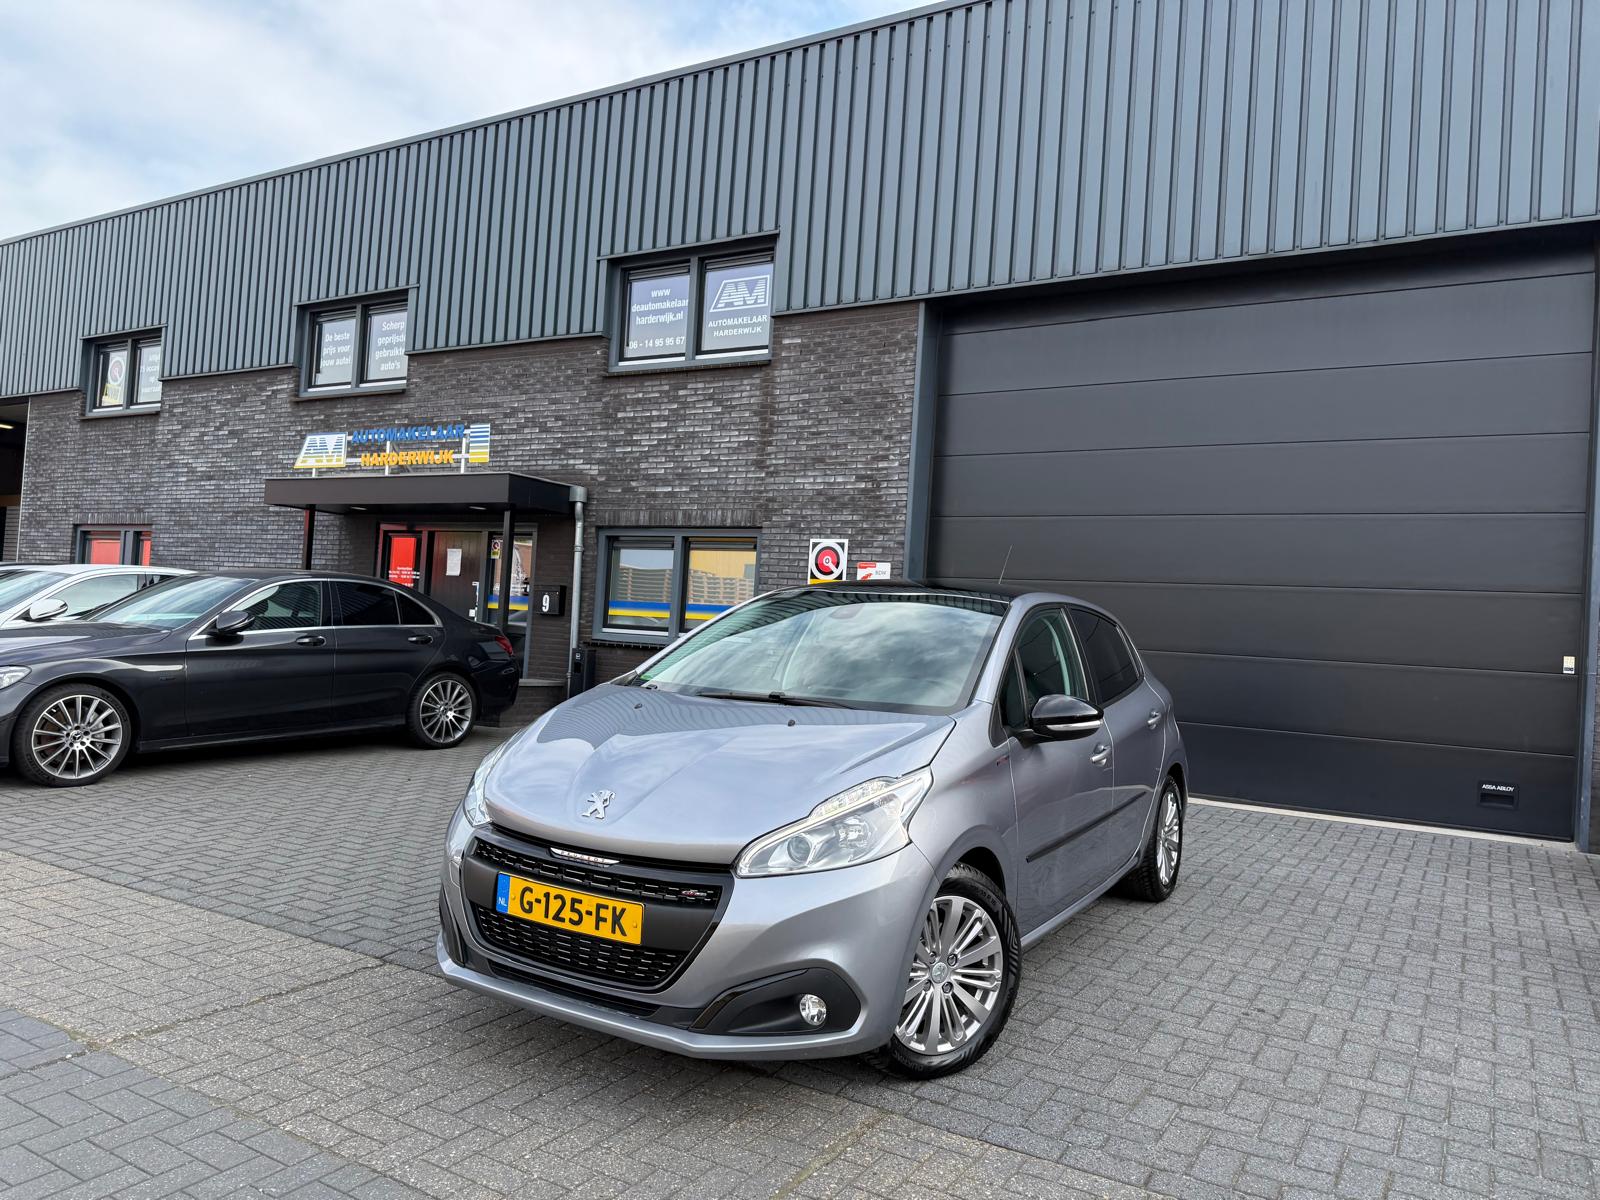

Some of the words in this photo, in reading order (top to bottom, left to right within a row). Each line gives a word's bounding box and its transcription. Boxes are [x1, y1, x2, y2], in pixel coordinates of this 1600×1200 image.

[651, 288, 671, 298] www
[636, 310, 683, 325] harderwijk.nl
[708, 314, 768, 328] AUTOMAKELAAR
[382, 320, 404, 331] Scherp
[713, 326, 762, 337] HARDERWIJK
[334, 331, 350, 341] beste
[630, 340, 638, 349] 06
[645, 339, 652, 348] 14
[655, 338, 664, 347] 95
[666, 337, 674, 346] 95
[676, 336, 685, 345] 67
[338, 344, 350, 353] voor
[381, 361, 400, 370] auto's
[351, 424, 464, 444] AUTOMAKELAAR
[360, 450, 454, 466] HARDERWIJK
[542, 594, 550, 612] 9
[497, 896, 507, 906] NL
[520, 886, 627, 936] G-125-FK
